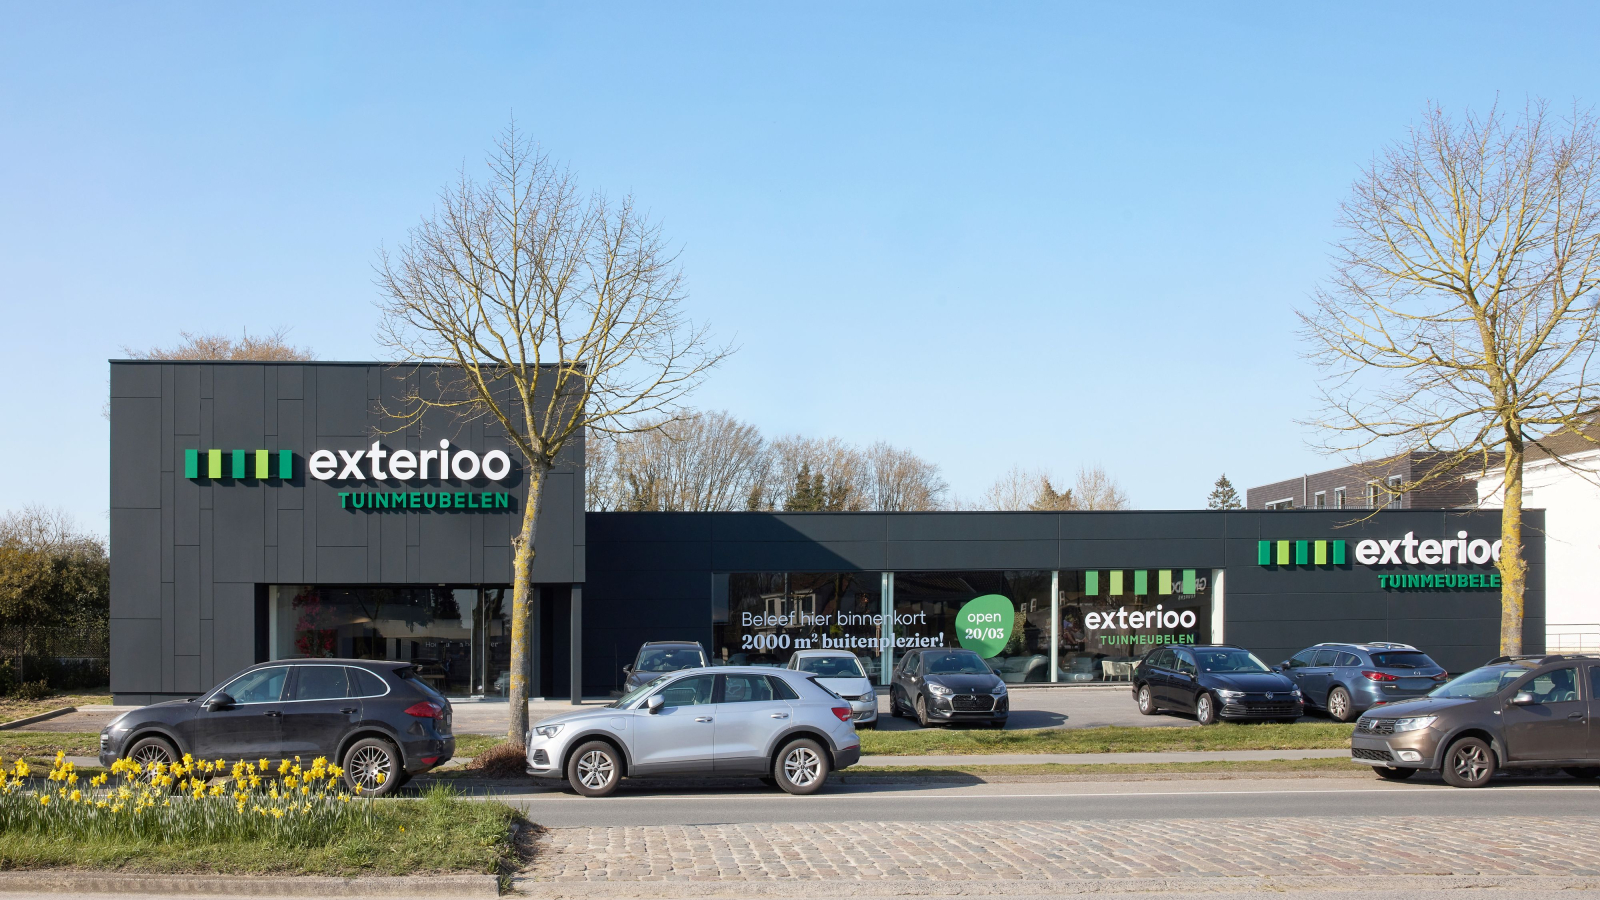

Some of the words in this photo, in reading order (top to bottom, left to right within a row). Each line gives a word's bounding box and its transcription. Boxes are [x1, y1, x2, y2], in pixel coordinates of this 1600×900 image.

[309, 438, 511, 481] exterioo
[338, 492, 509, 509] TUINMEUBELEN
[1378, 573, 1502, 589] TUINMEUBELE
[742, 610, 795, 627] Beleef
[801, 610, 832, 626] hier
[837, 610, 926, 626] binnenkort
[967, 612, 1002, 626] open
[1085, 604, 1196, 630] exterioo
[741, 634, 791, 650] 2000
[822, 631, 944, 652] buitenplezier!
[965, 627, 1004, 641] 20/03
[1100, 633, 1194, 645] TUINMEUBELEN
